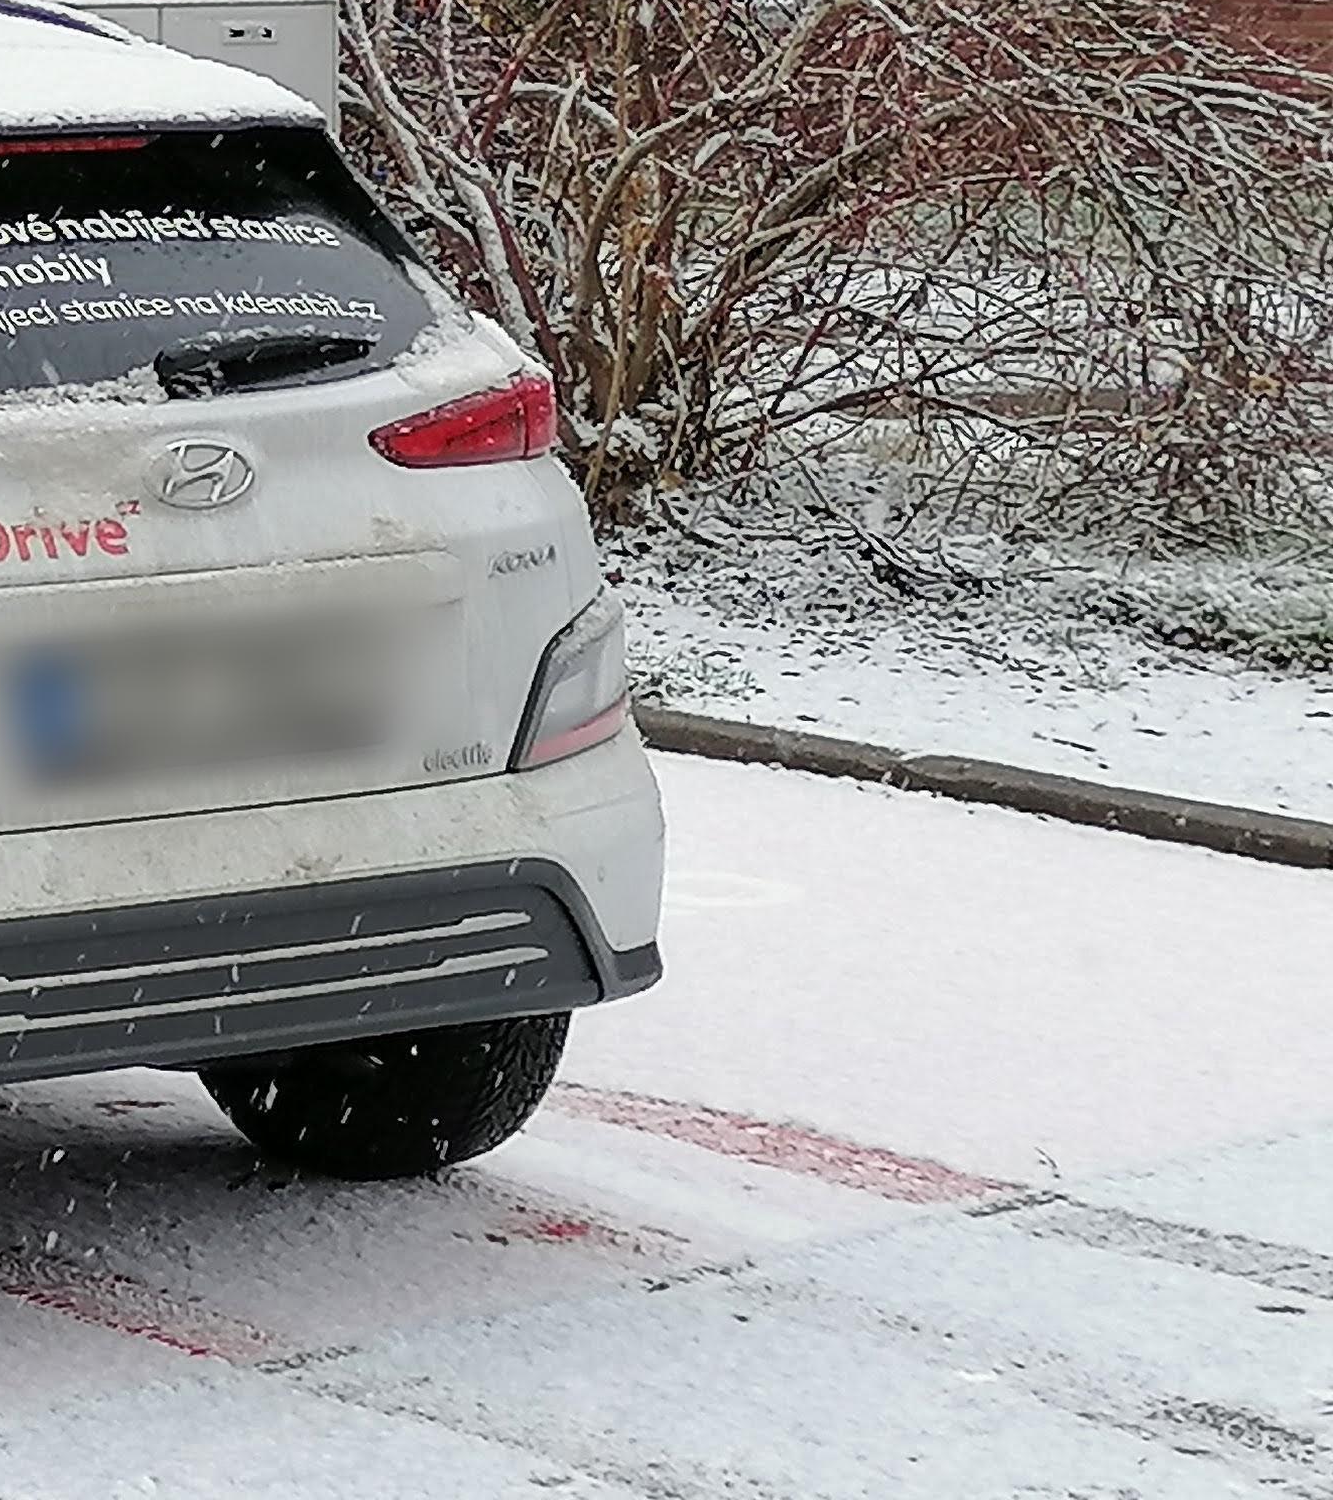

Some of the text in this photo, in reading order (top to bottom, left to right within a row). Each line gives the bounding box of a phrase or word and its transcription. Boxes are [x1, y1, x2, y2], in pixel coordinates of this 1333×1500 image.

[57, 206, 211, 243] nabíjecí
[209, 214, 341, 247] stanice
[60, 292, 174, 322] stanice
[173, 296, 220, 316] na
